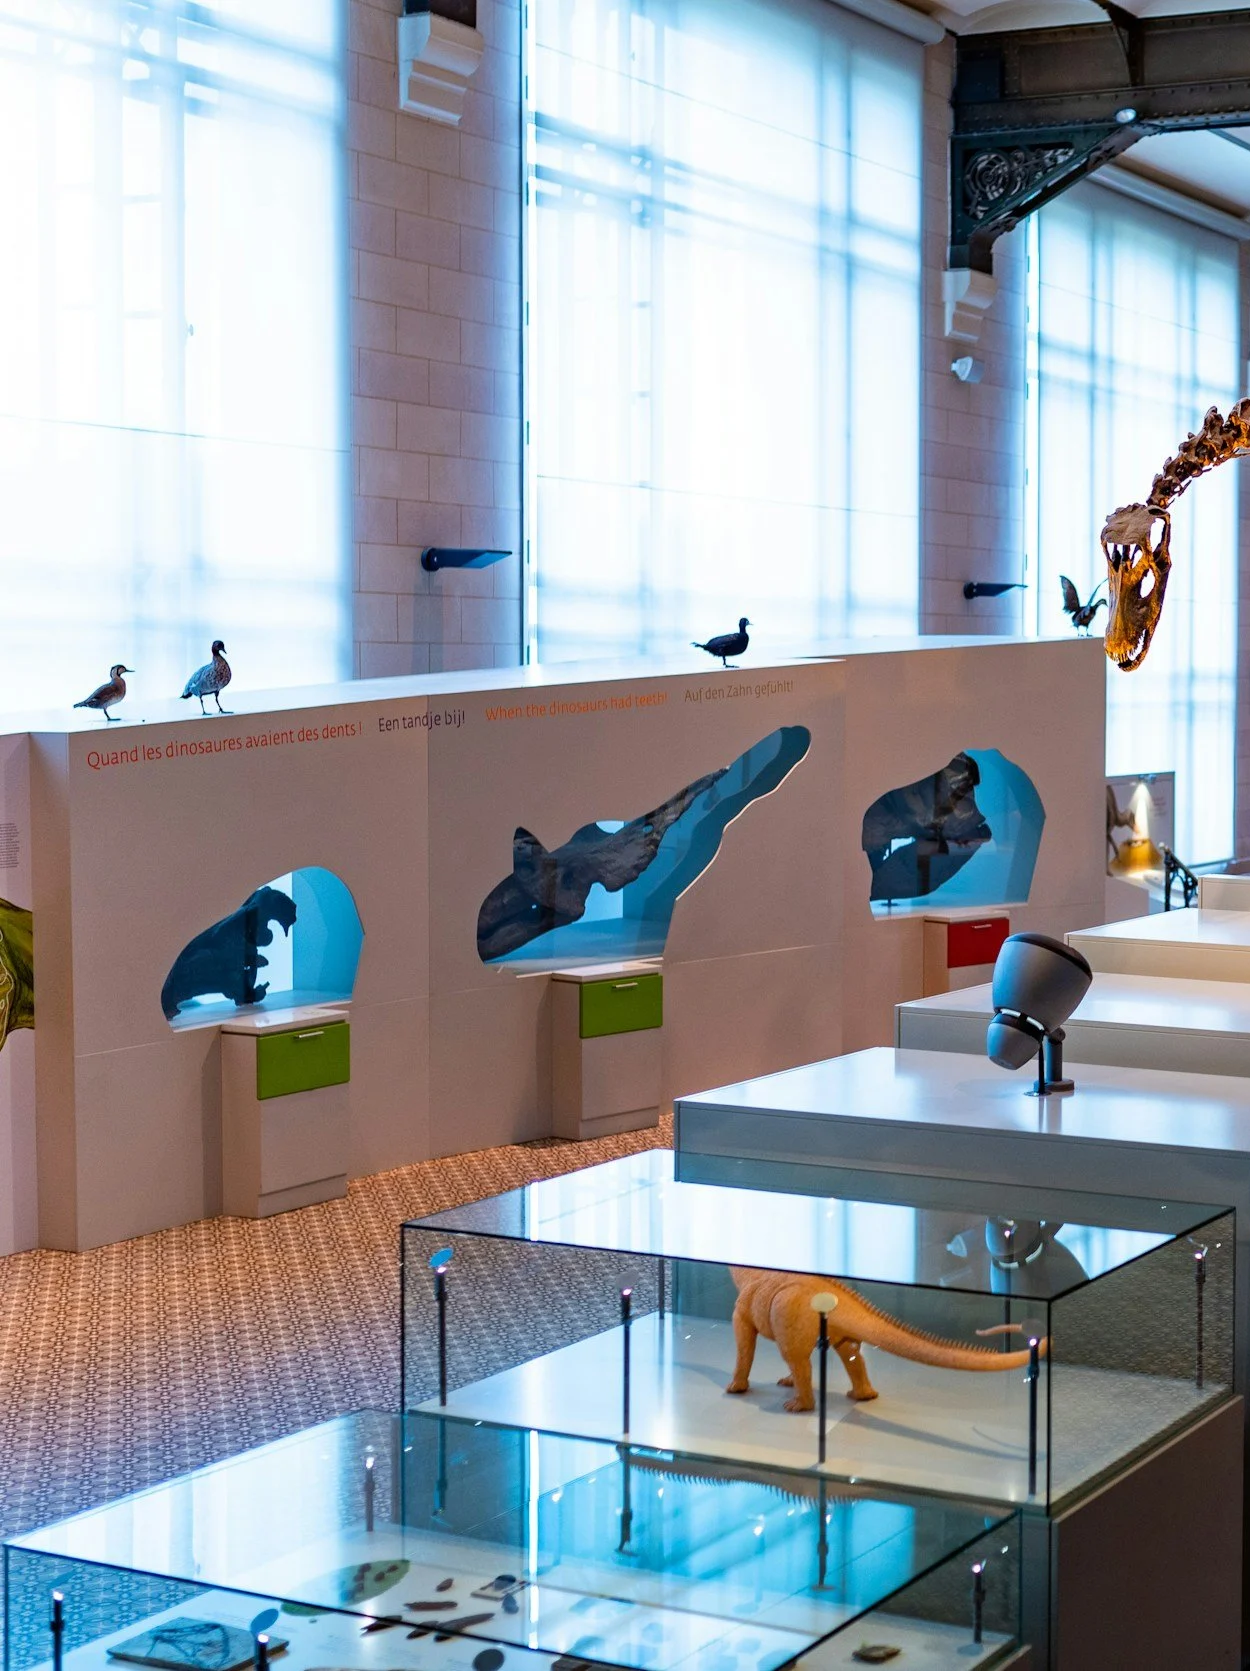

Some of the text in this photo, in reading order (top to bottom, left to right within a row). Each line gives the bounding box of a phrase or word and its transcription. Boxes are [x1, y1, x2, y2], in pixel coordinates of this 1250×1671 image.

[684, 687, 703, 703] Auf
[705, 687, 724, 700] den
[727, 684, 752, 698] Zahn
[485, 704, 522, 721] When
[526, 703, 546, 717] the
[549, 699, 608, 717] dinosaurs
[610, 693, 632, 710] had
[378, 709, 465, 732] Een tandje bij!
[87, 745, 138, 770] Quand
[142, 744, 162, 761] les
[165, 735, 242, 758] dinosaures
[245, 728, 295, 748] avaient
[297, 726, 319, 742] des
[322, 722, 356, 739] dents
